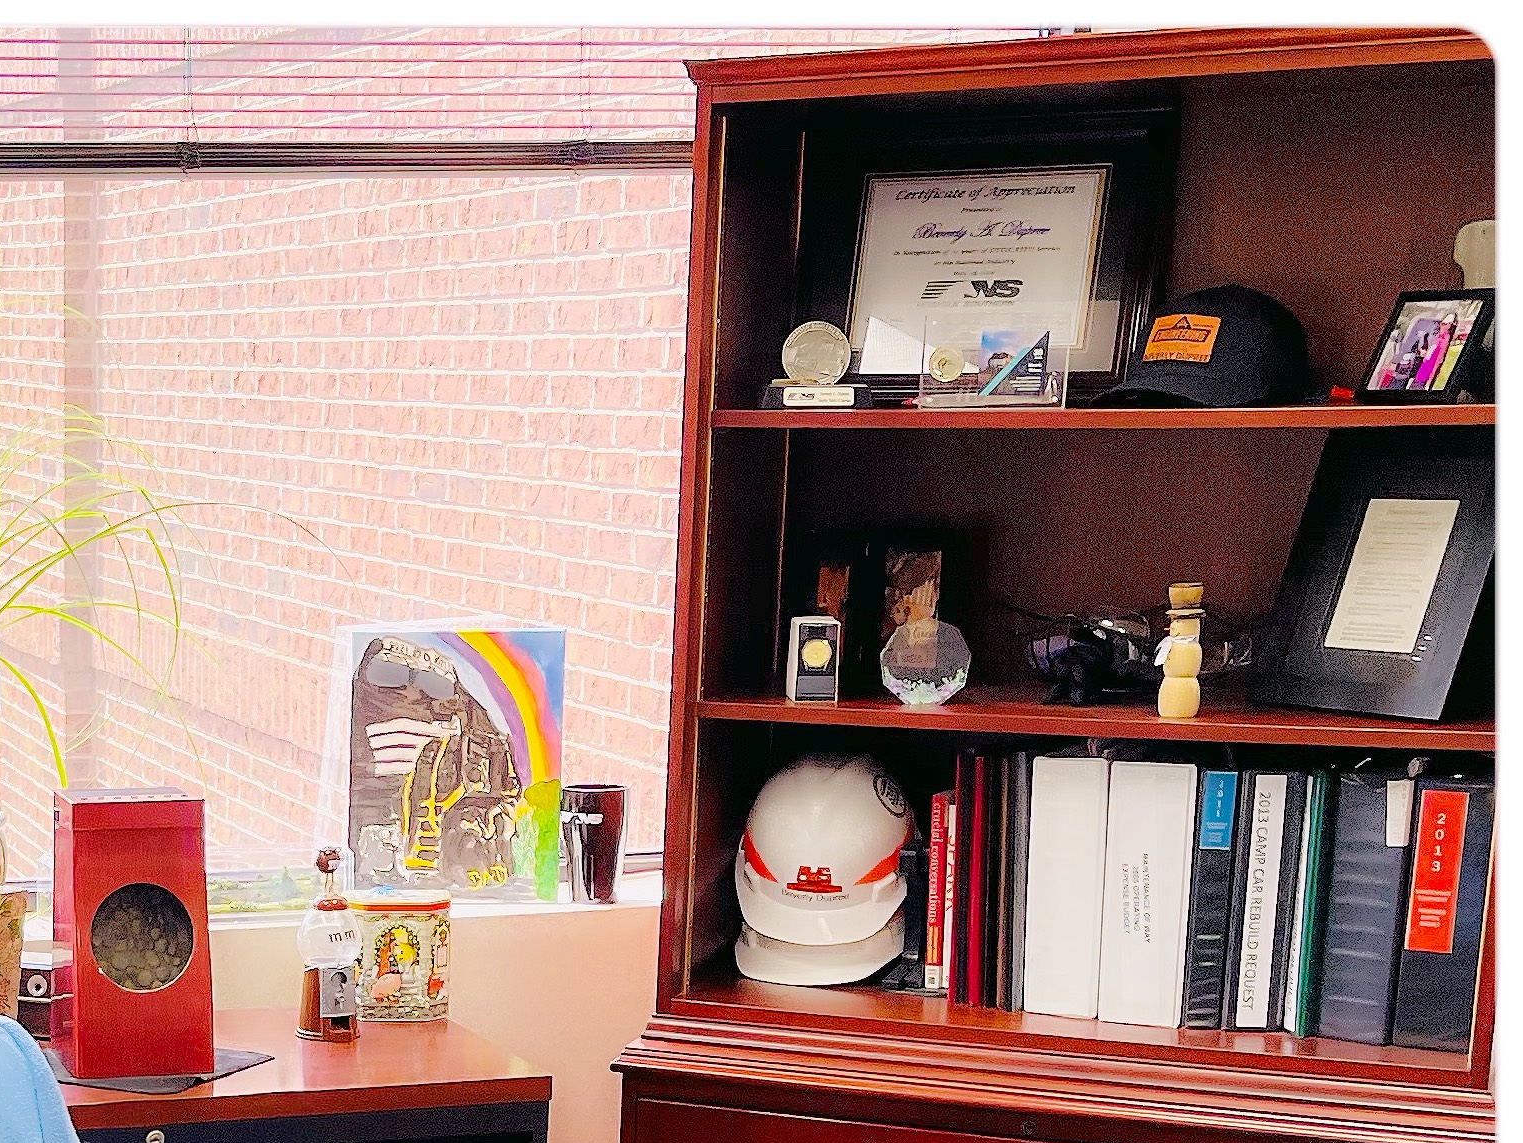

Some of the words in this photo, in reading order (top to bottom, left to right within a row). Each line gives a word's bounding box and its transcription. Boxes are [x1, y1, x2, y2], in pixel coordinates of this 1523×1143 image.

[895, 186, 965, 203] Certificate
[968, 185, 983, 201] of
[931, 801, 944, 843] crucial
[1257, 791, 1272, 824] 2013
[1254, 826, 1269, 866] CAMP
[1429, 812, 1447, 873] 2013
[927, 845, 940, 924] conversations
[1251, 868, 1266, 894] CAR
[1246, 896, 1263, 950] REBUILD
[1240, 953, 1259, 1011] REQUEST
